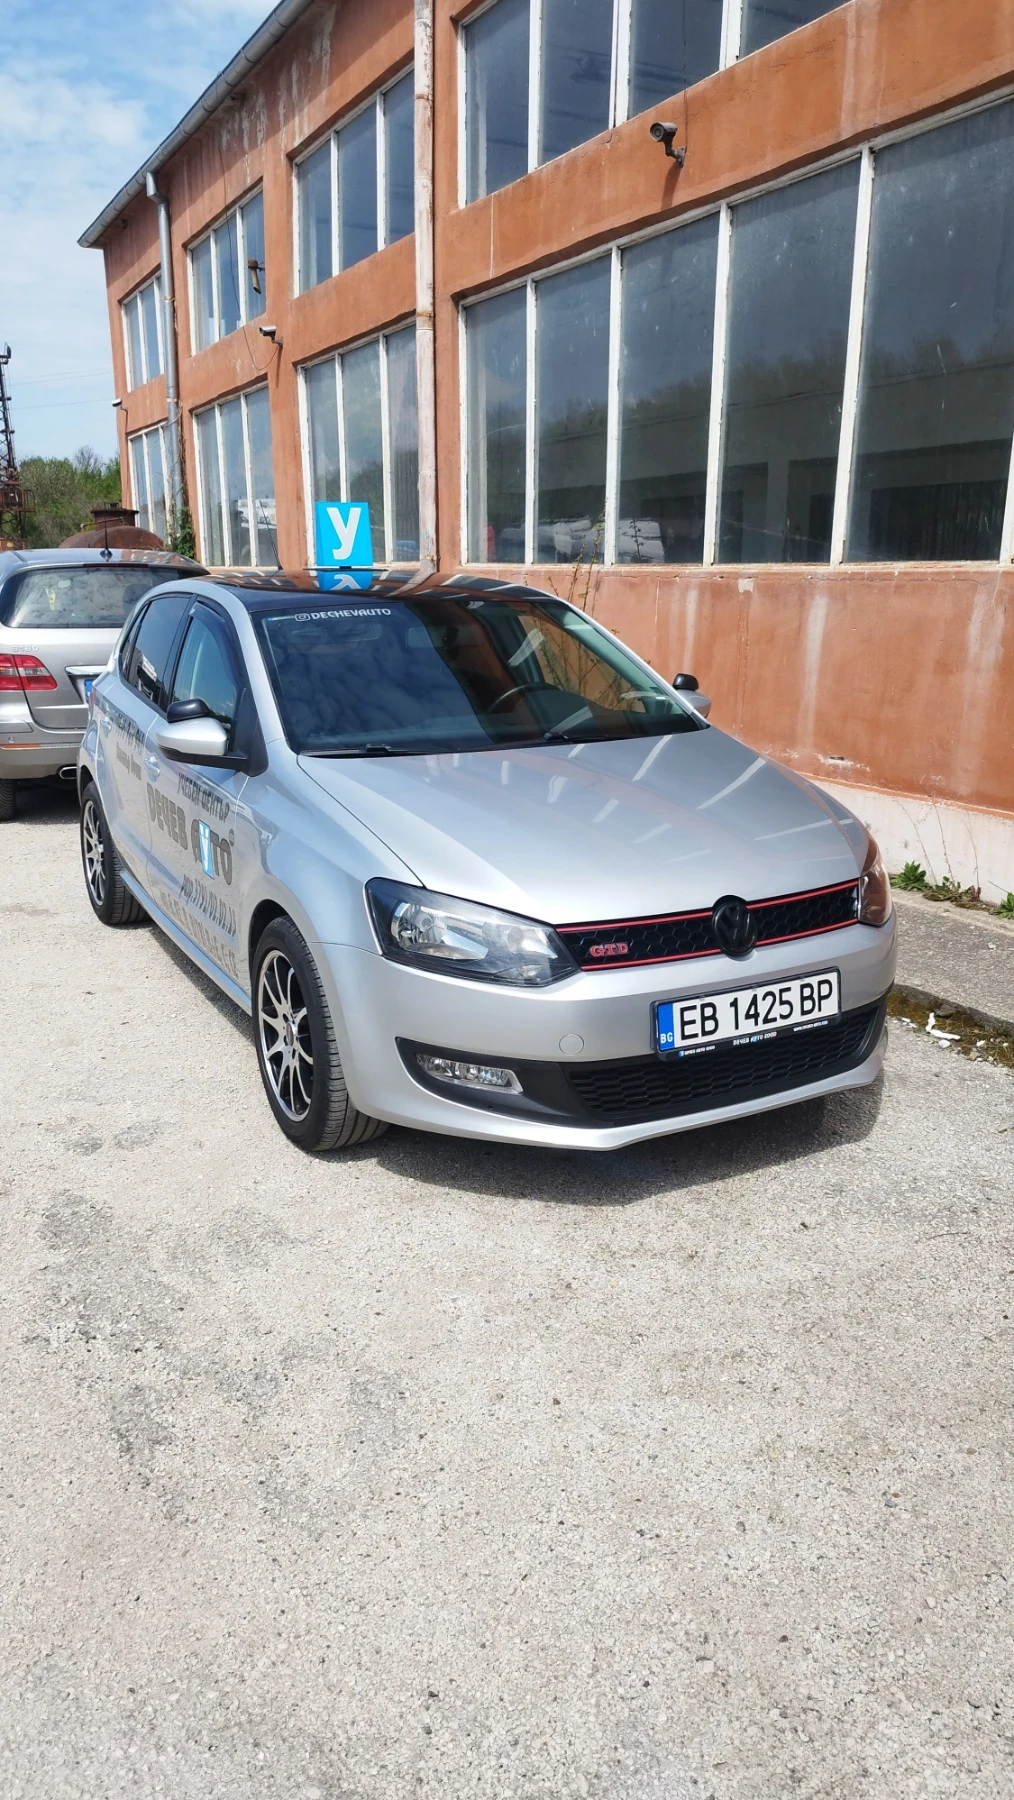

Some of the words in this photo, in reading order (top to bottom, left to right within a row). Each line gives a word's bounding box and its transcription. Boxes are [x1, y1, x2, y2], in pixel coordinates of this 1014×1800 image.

[310, 608, 391, 620] DECHEVAUTO
[589, 942, 629, 957] GTD
[680, 1001, 719, 1041] EB
[729, 986, 794, 1031] 1425
[799, 978, 833, 1016] BP
[660, 1032, 673, 1043] BG
